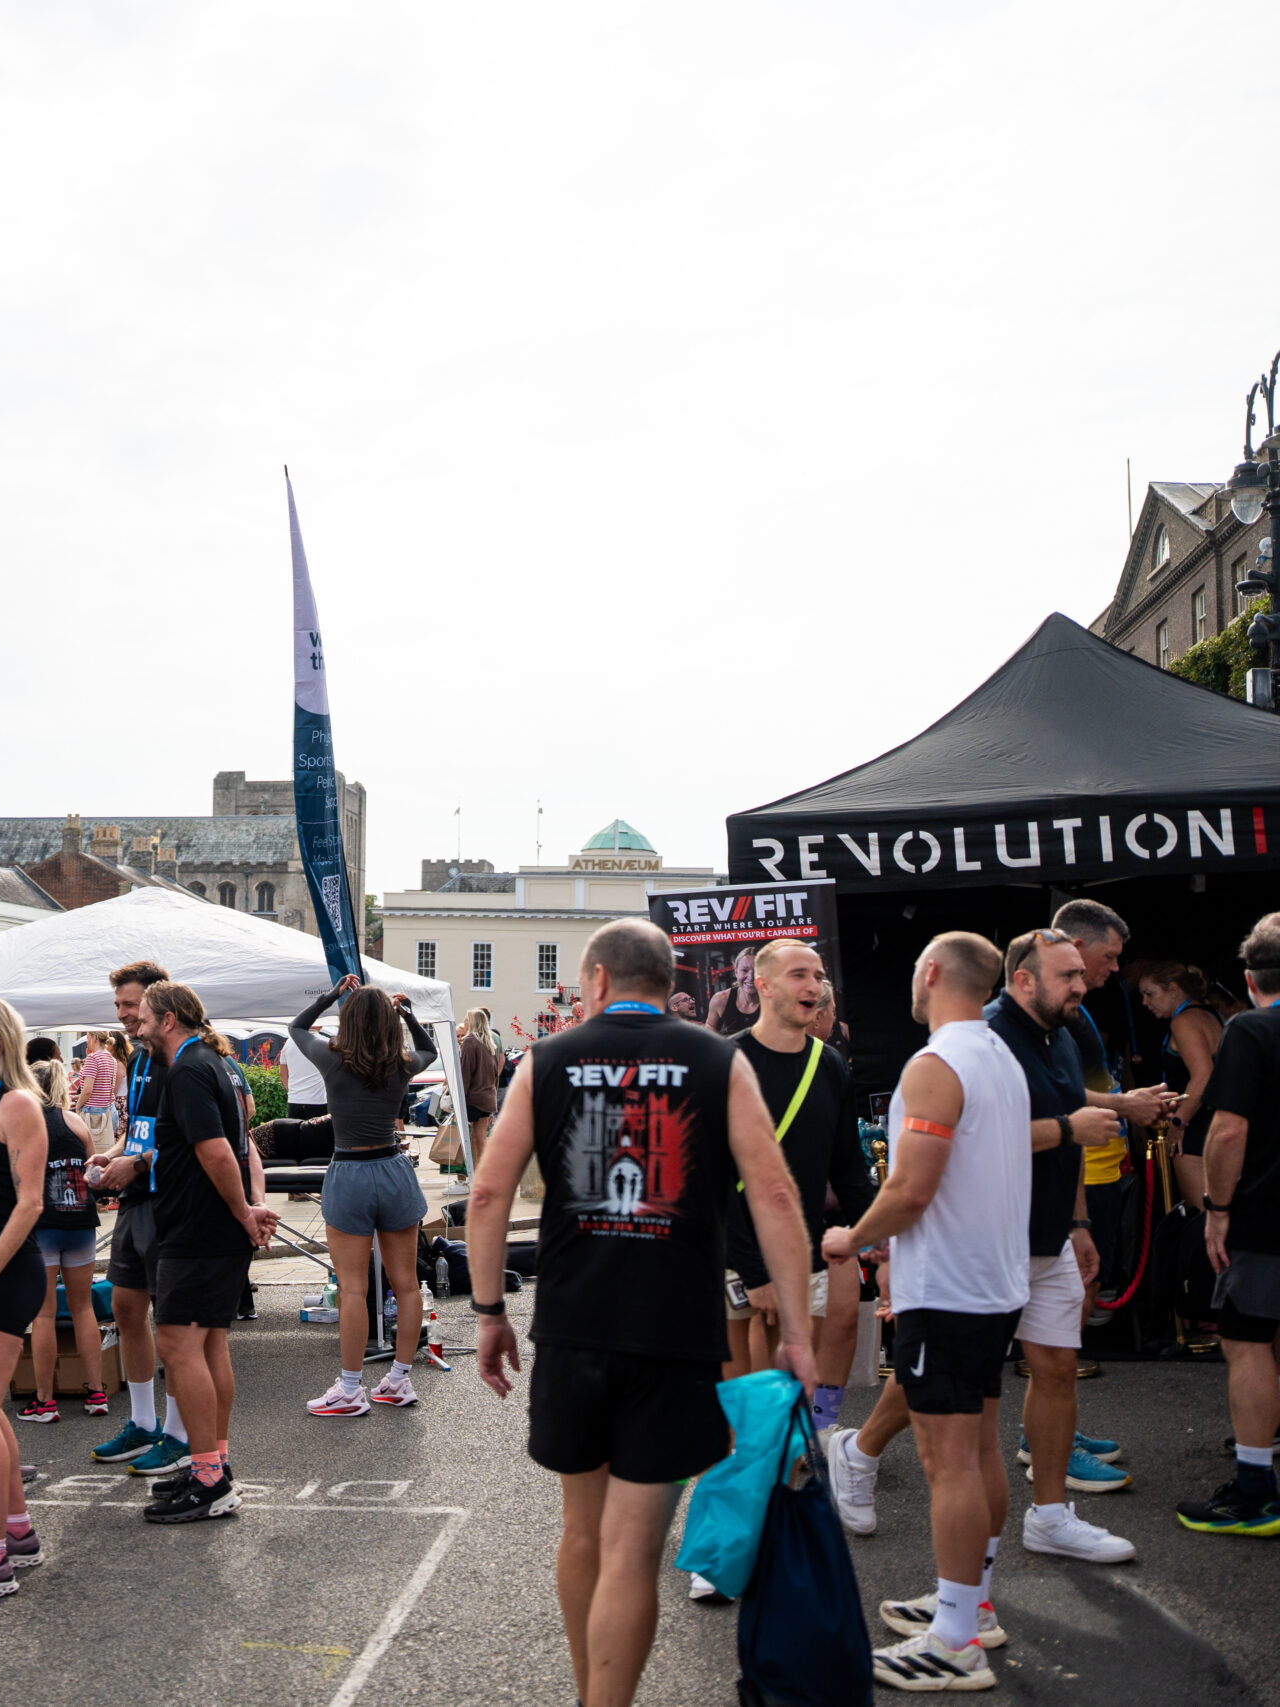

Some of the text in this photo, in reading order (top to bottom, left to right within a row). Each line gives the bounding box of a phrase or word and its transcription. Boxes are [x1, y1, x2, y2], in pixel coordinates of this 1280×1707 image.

[672, 917, 813, 933] START WHERE YOU ARE
[673, 927, 814, 943] DISCOVER WHAT YOU'RE CAPABLE OF
[131, 1120, 150, 1140] 78
